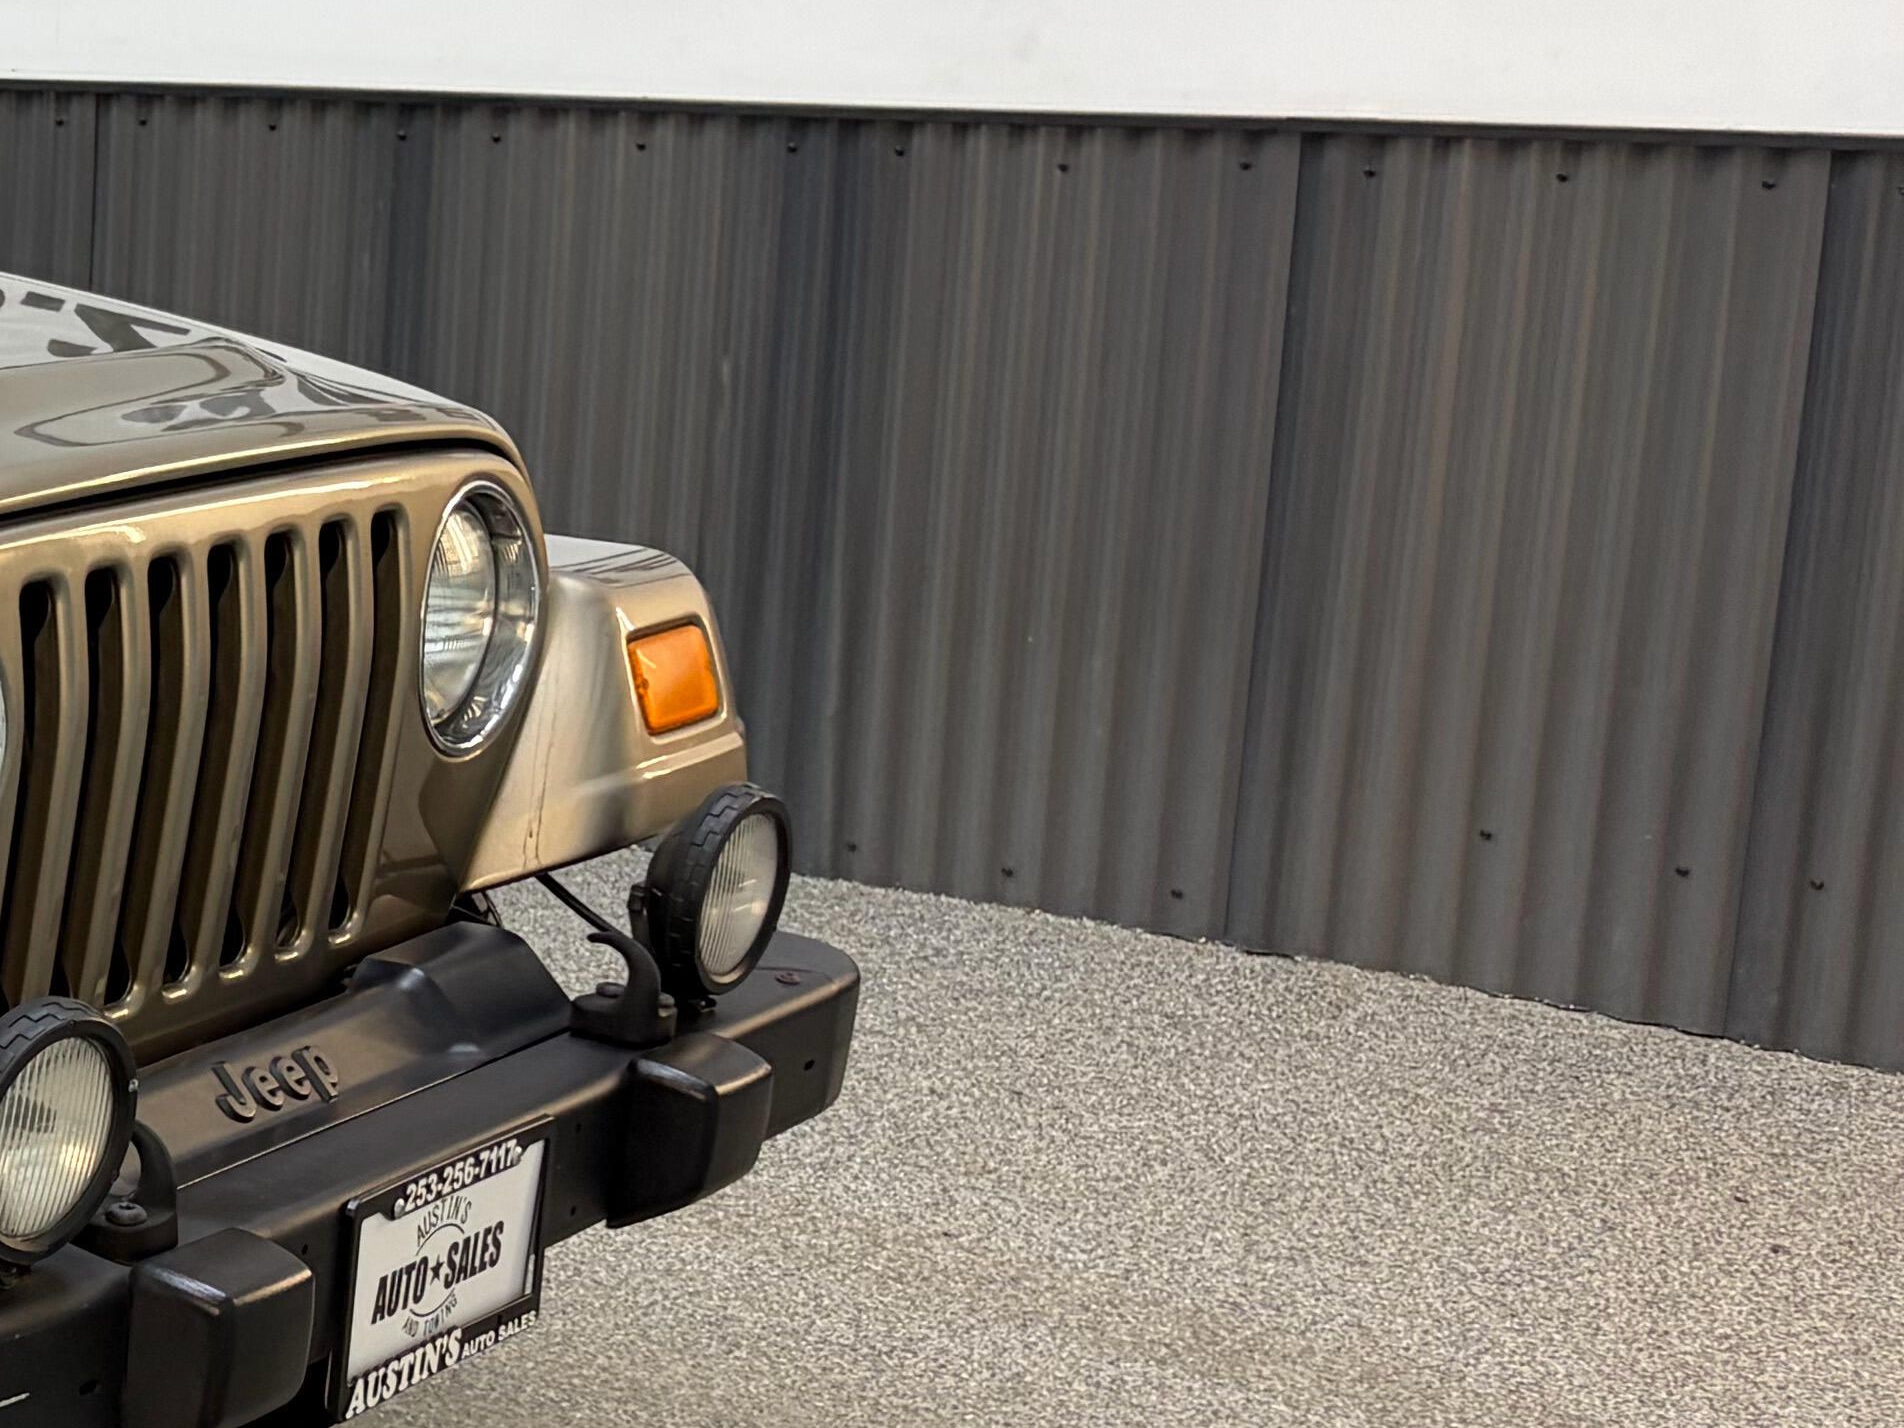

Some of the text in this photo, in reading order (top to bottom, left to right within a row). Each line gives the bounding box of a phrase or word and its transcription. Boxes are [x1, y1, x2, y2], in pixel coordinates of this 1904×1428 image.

[210, 1045, 339, 1124] Jeep
[404, 1139, 518, 1213] 253-256-7117
[416, 1194, 473, 1248] AUSTIN'S
[371, 1220, 505, 1325] AUTO SALES
[345, 1310, 537, 1420] AUSTIN'S AUTO SALES
